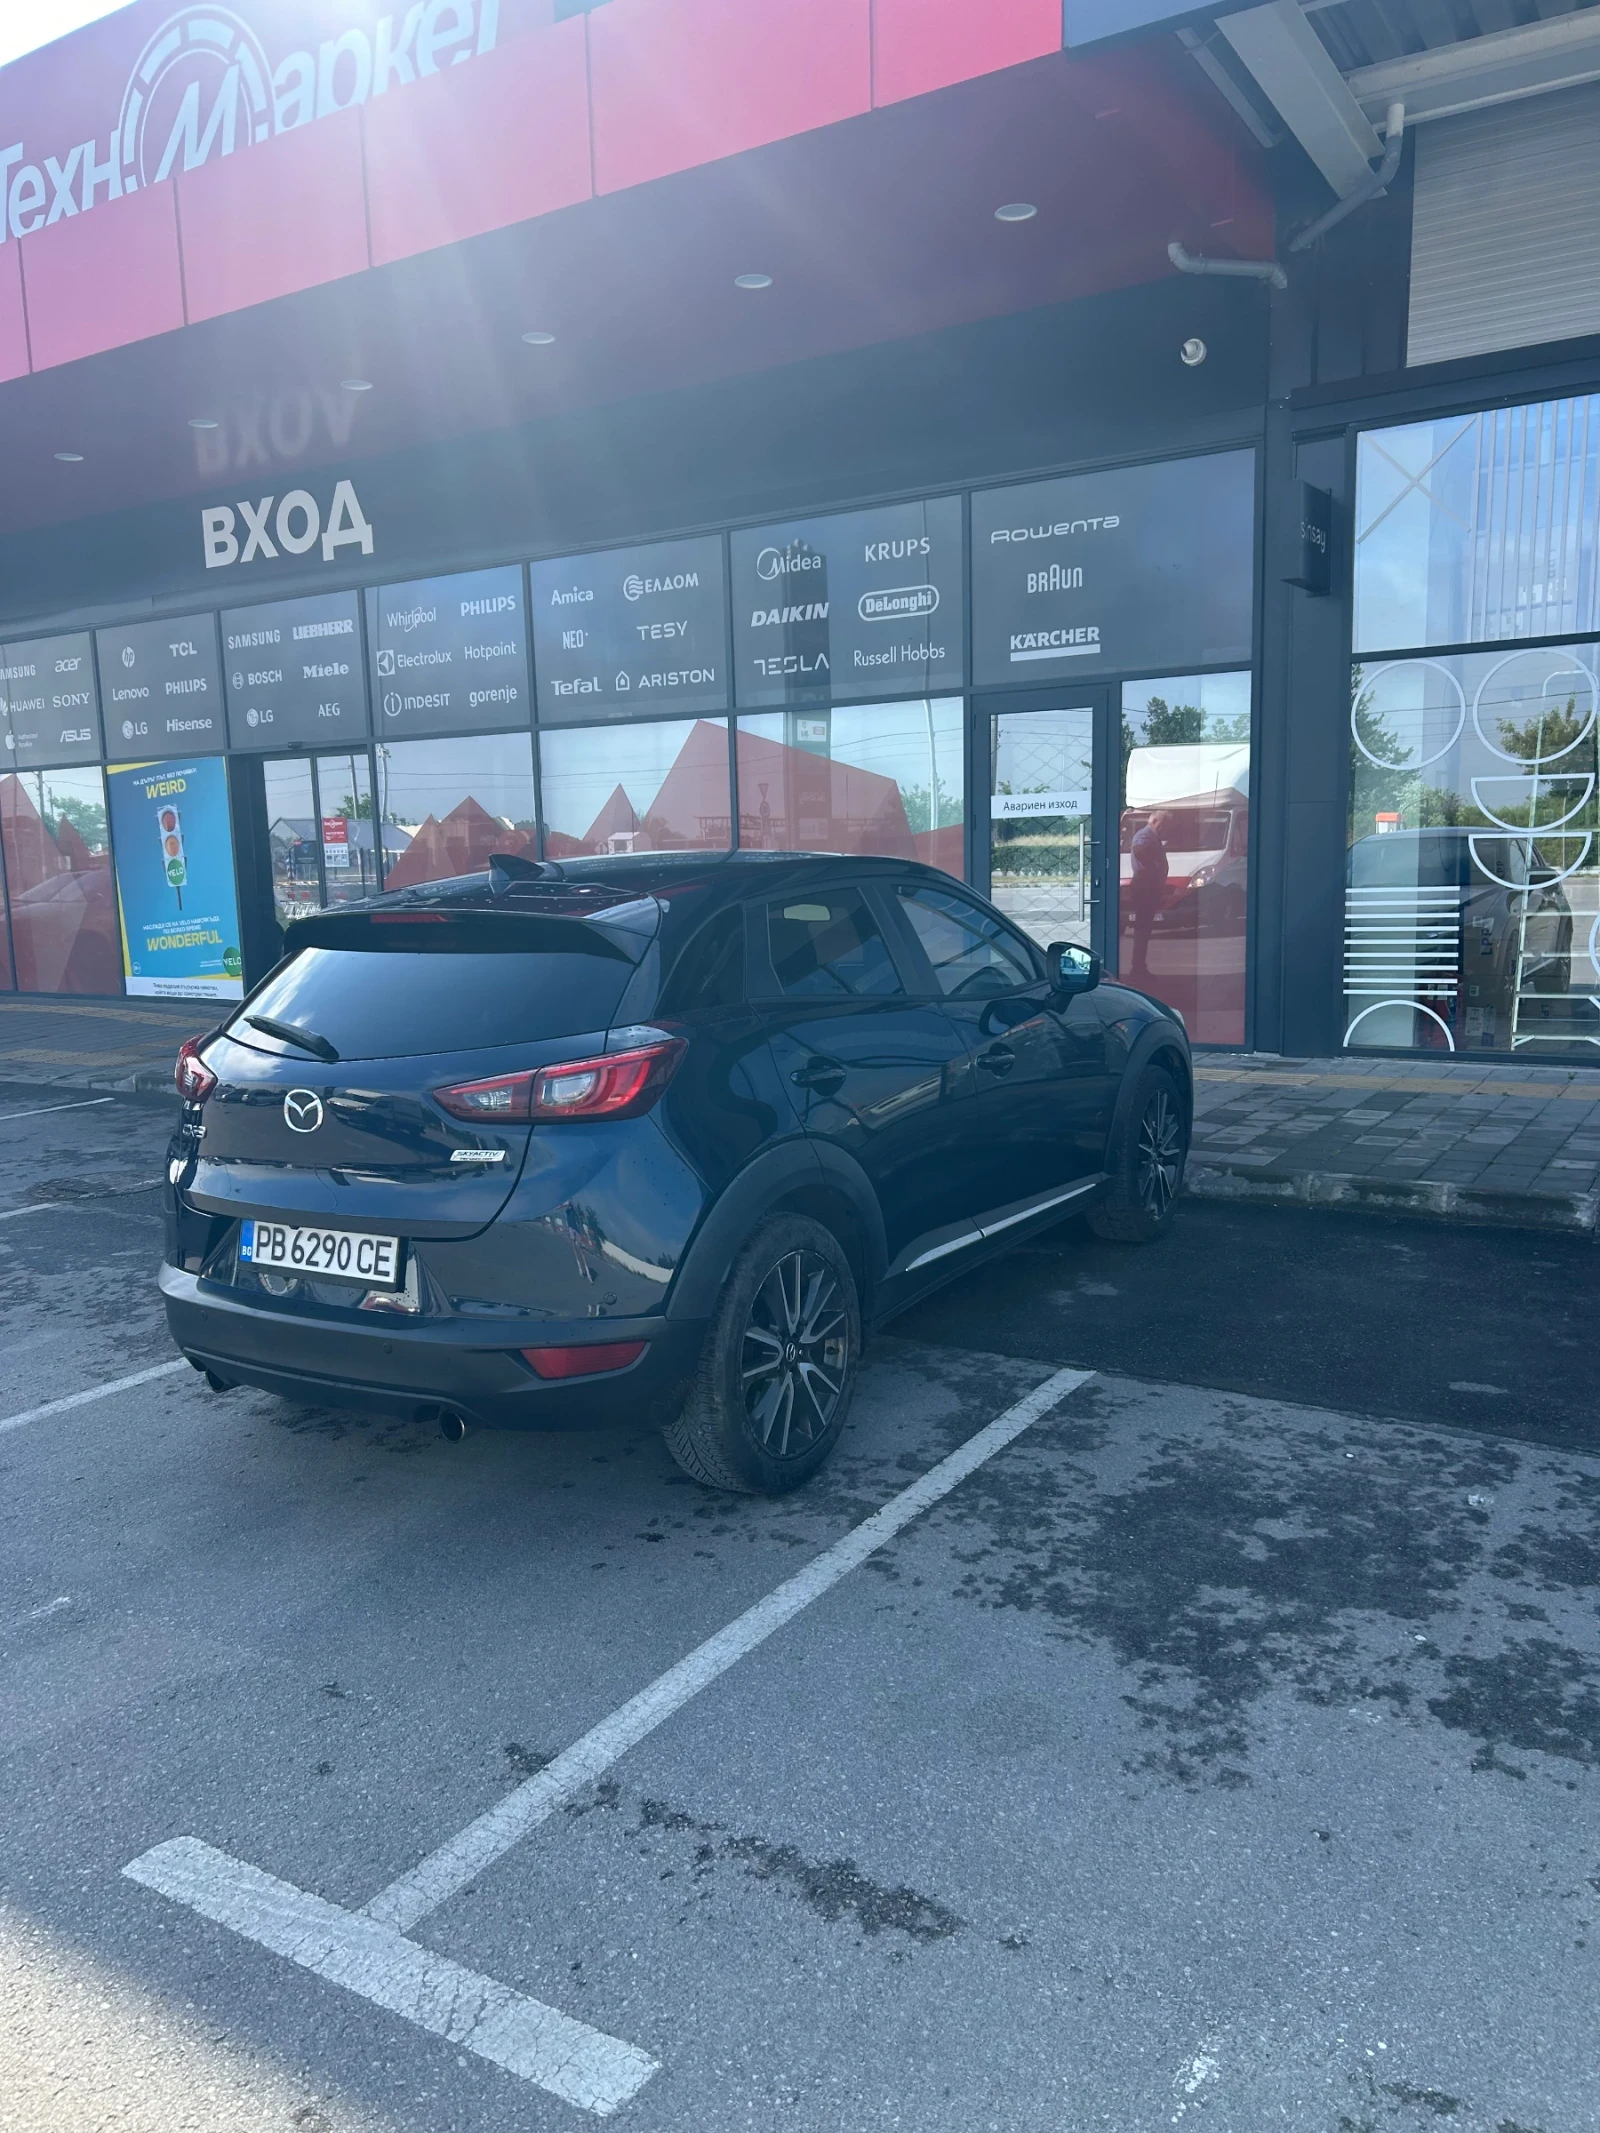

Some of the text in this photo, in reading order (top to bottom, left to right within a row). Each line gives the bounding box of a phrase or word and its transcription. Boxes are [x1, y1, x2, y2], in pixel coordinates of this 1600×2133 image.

[201, 479, 374, 569] ВХОД
[864, 537, 931, 563] KRUPS
[757, 548, 822, 579] Midea
[460, 595, 516, 617] PHILIPS
[551, 586, 594, 606] Amica
[387, 607, 437, 631] Whirlpool
[750, 602, 829, 627] DAIKIN
[228, 629, 281, 649] SAMSUNG
[292, 619, 354, 641] LIEBHERR
[636, 620, 688, 641] TESY
[1010, 625, 1100, 651] KÄRCHER
[122, 646, 135, 668] hp
[169, 641, 198, 658] TCL
[397, 650, 452, 668] Electrolux
[464, 641, 517, 661] Hotpoint
[854, 642, 945, 667] Russell Hobbs
[0, 664, 36, 680] AMSUNG
[55, 657, 82, 673] acer
[303, 662, 349, 679] Miele
[754, 652, 830, 676] TESLA
[165, 678, 208, 695] PHILIPS
[248, 670, 283, 686] BOSCH
[551, 676, 603, 696] Tefal
[638, 668, 715, 689] ARISTON
[53, 692, 91, 708] SONY
[112, 687, 149, 701] Lenovo
[469, 684, 518, 707] gorenje
[10, 698, 45, 713] HUAWEI
[318, 702, 341, 718] AEG
[166, 717, 213, 733] Hisense
[260, 709, 274, 724] LG
[60, 728, 92, 743] ASUS
[135, 721, 148, 736] LG
[146, 778, 187, 799] WEIRD
[1003, 799, 1078, 813] Авариен изход
[147, 929, 223, 952] WONDERFUL
[291, 1228, 351, 1272] 6290
